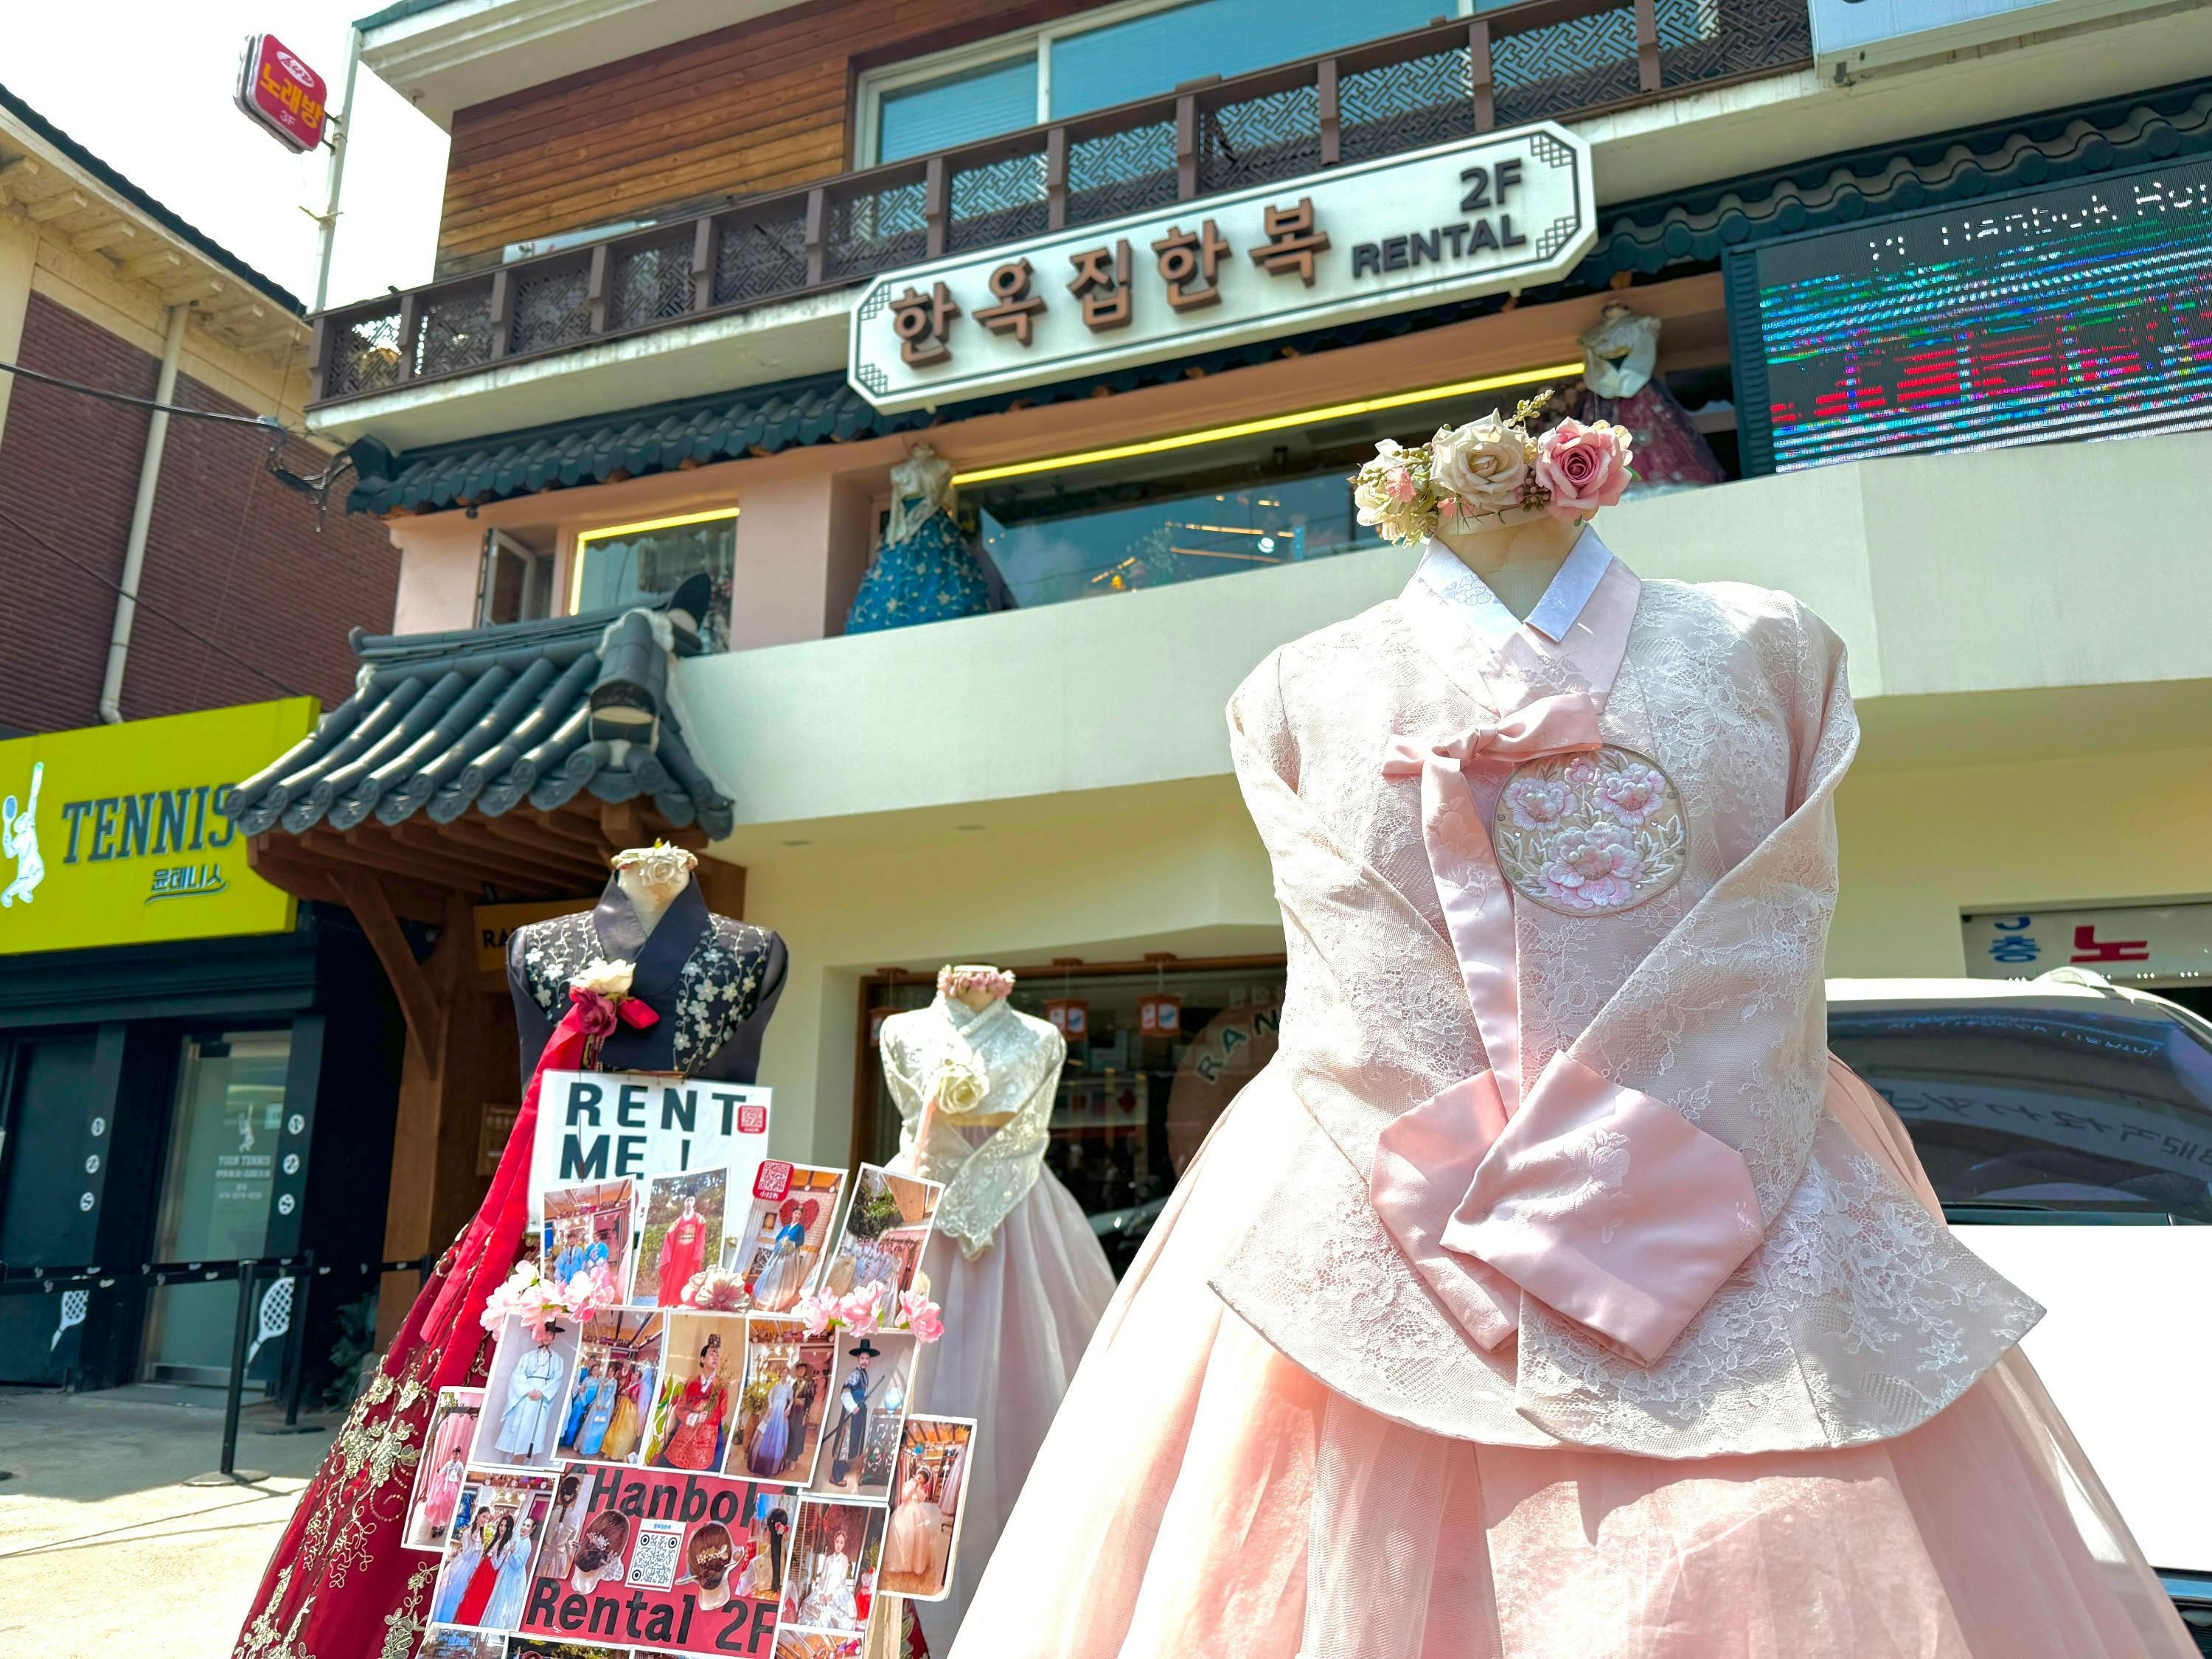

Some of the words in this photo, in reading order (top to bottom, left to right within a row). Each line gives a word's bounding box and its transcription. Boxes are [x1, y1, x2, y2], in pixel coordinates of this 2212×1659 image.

[260, 63, 324, 129] 노래방
[280, 110, 296, 126] 3F
[1458, 159, 1523, 212] 2F
[1352, 215, 1527, 279] RENTAL
[889, 195, 1331, 369] 한옥집한복
[62, 783, 237, 863] TENNIS
[482, 928, 514, 949] RA
[566, 1082, 746, 1136] RENT
[559, 1134, 647, 1180] ME
[526, 1576, 696, 1644] Rental
[715, 1599, 779, 1652] 2F
